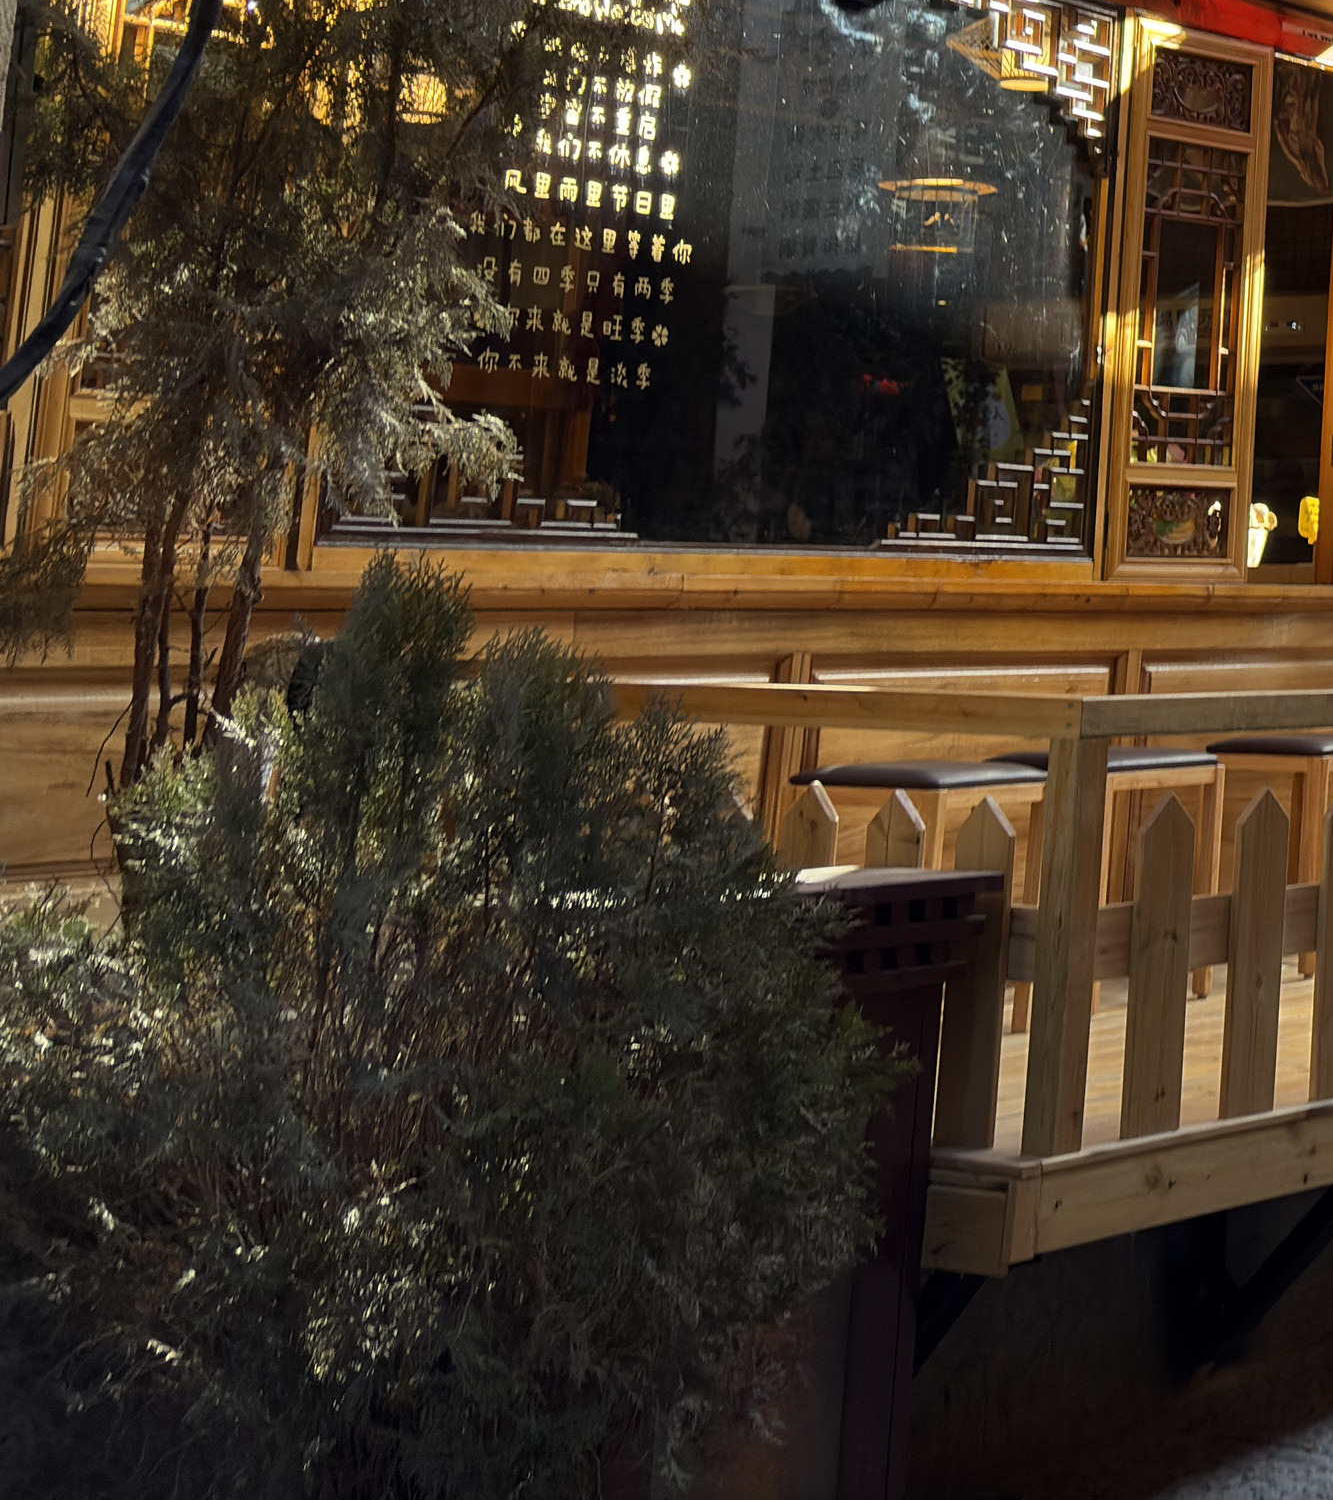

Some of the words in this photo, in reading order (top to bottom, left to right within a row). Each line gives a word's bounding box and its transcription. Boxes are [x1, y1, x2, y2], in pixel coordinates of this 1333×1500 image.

[536, 128, 652, 176] 我们不休息
[504, 169, 677, 221] 风里雨里节日里
[469, 210, 693, 265] 我们都在这里等着你
[476, 256, 675, 305] 没有四季只有两季
[477, 347, 651, 390] 你不来就是淡季
